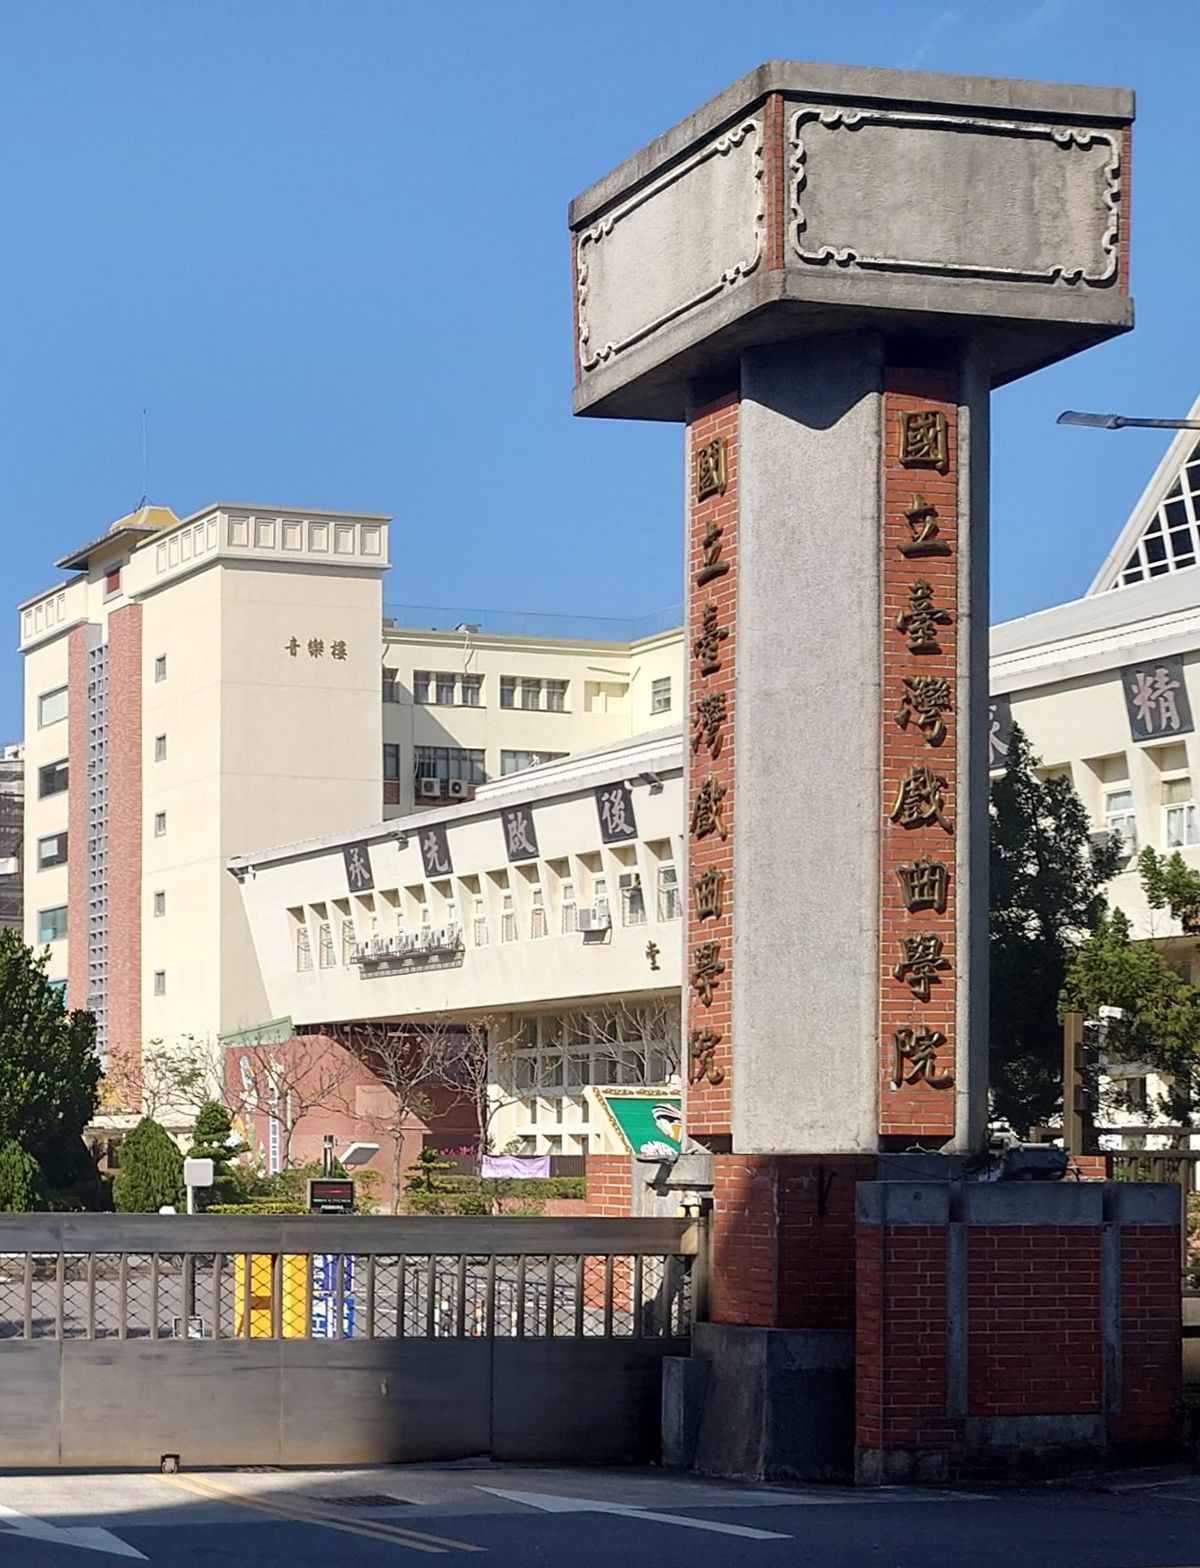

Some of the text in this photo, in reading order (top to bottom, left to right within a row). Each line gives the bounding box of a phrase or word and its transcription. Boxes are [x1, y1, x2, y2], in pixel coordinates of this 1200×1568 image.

[285, 636, 348, 661] 音樂樓
[689, 436, 730, 1086] 國立臺灣戲曲學院
[891, 410, 954, 1089] 國立臺灣戲曲學院
[1130, 668, 1180, 733] 精
